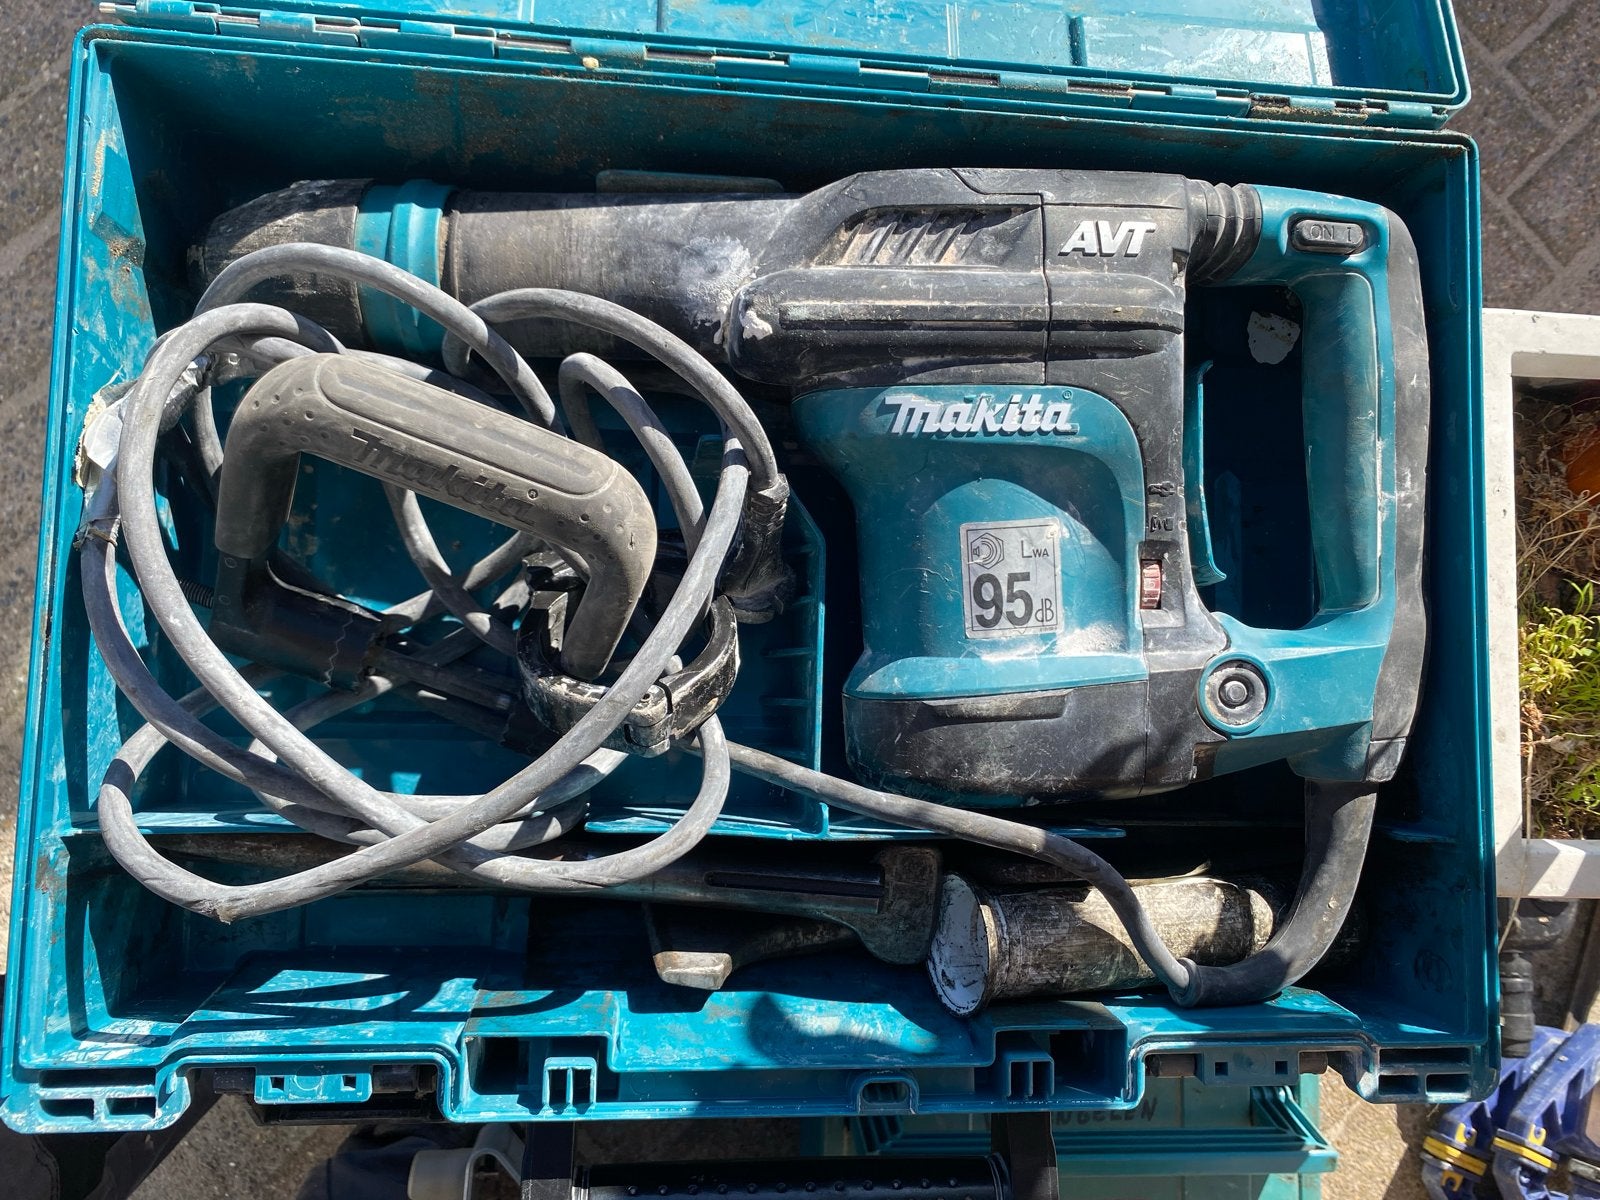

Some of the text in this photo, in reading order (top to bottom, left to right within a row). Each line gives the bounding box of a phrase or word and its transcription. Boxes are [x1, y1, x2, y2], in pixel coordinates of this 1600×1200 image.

[1058, 219, 1157, 257] AVT
[1311, 223, 1335, 241] ON
[884, 392, 1080, 437] Makita
[972, 571, 1055, 629] 95 dB
